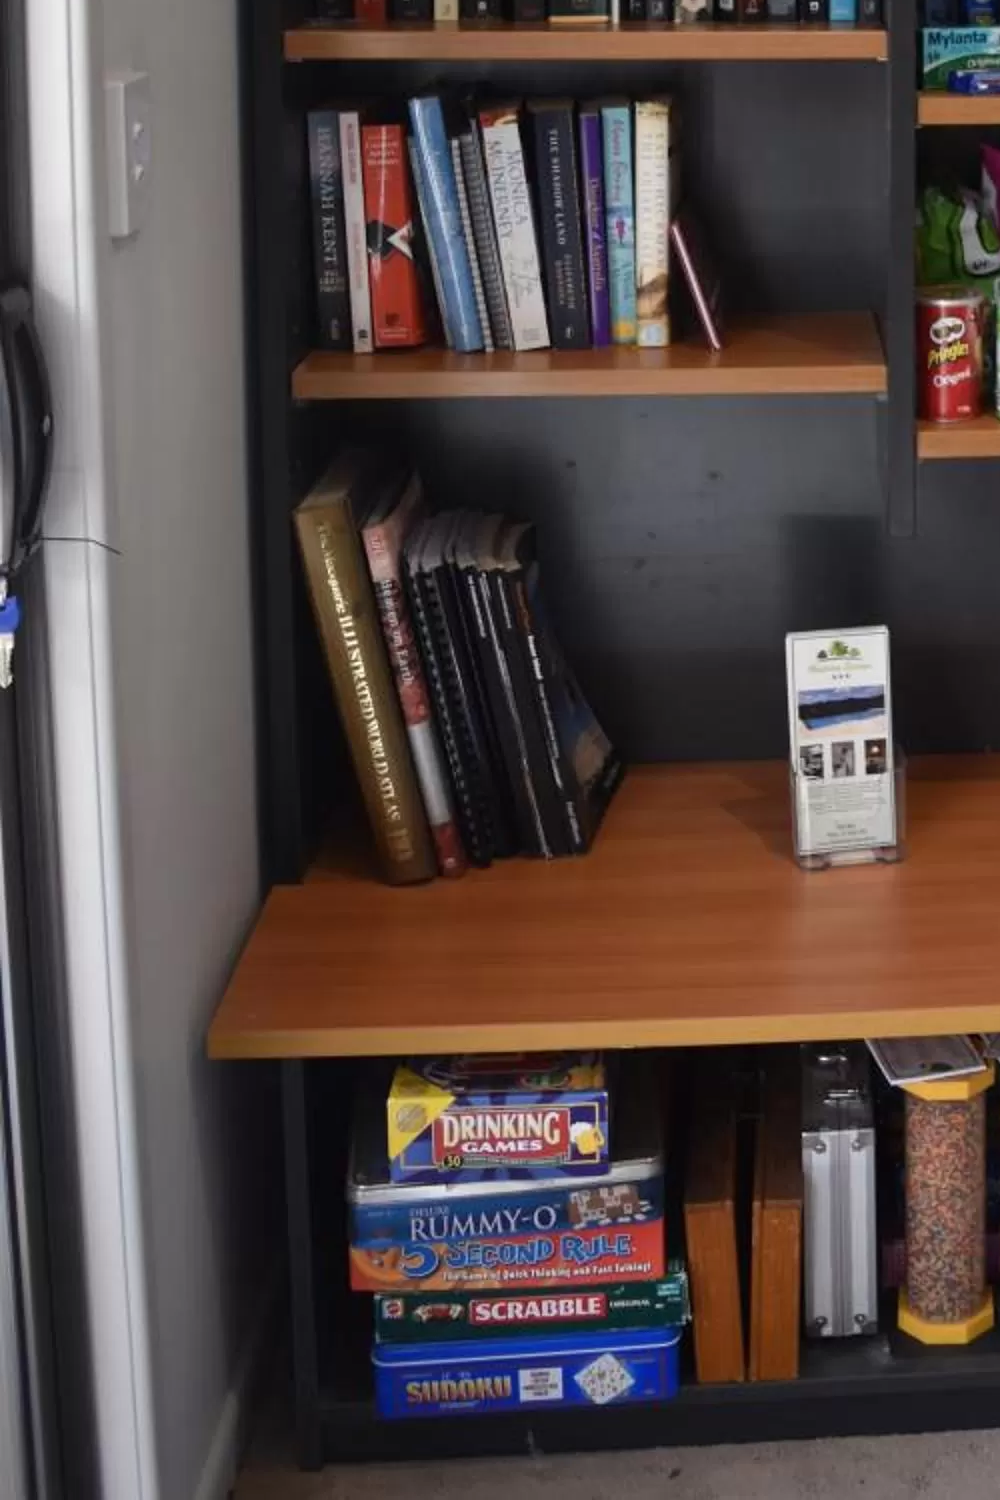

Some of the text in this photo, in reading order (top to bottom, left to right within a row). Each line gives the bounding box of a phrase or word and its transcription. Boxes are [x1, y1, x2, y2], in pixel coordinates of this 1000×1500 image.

[927, 31, 987, 48] Mylanta
[548, 129, 559, 154] THE
[318, 127, 337, 210] HANNAH
[505, 148, 529, 226] MONICA
[321, 215, 338, 266] KENT
[553, 212, 566, 246] LAND
[927, 342, 969, 369] Pringles
[397, 650, 415, 684] Earth
[441, 1111, 561, 1148] DRINKING
[461, 1139, 543, 1153] GAMES
[410, 1205, 557, 1242] RUMMY-O
[401, 1234, 632, 1279] 5 SECOND RULE
[475, 1297, 601, 1321] SCRABBLE
[405, 1375, 512, 1406] SUDOKU
